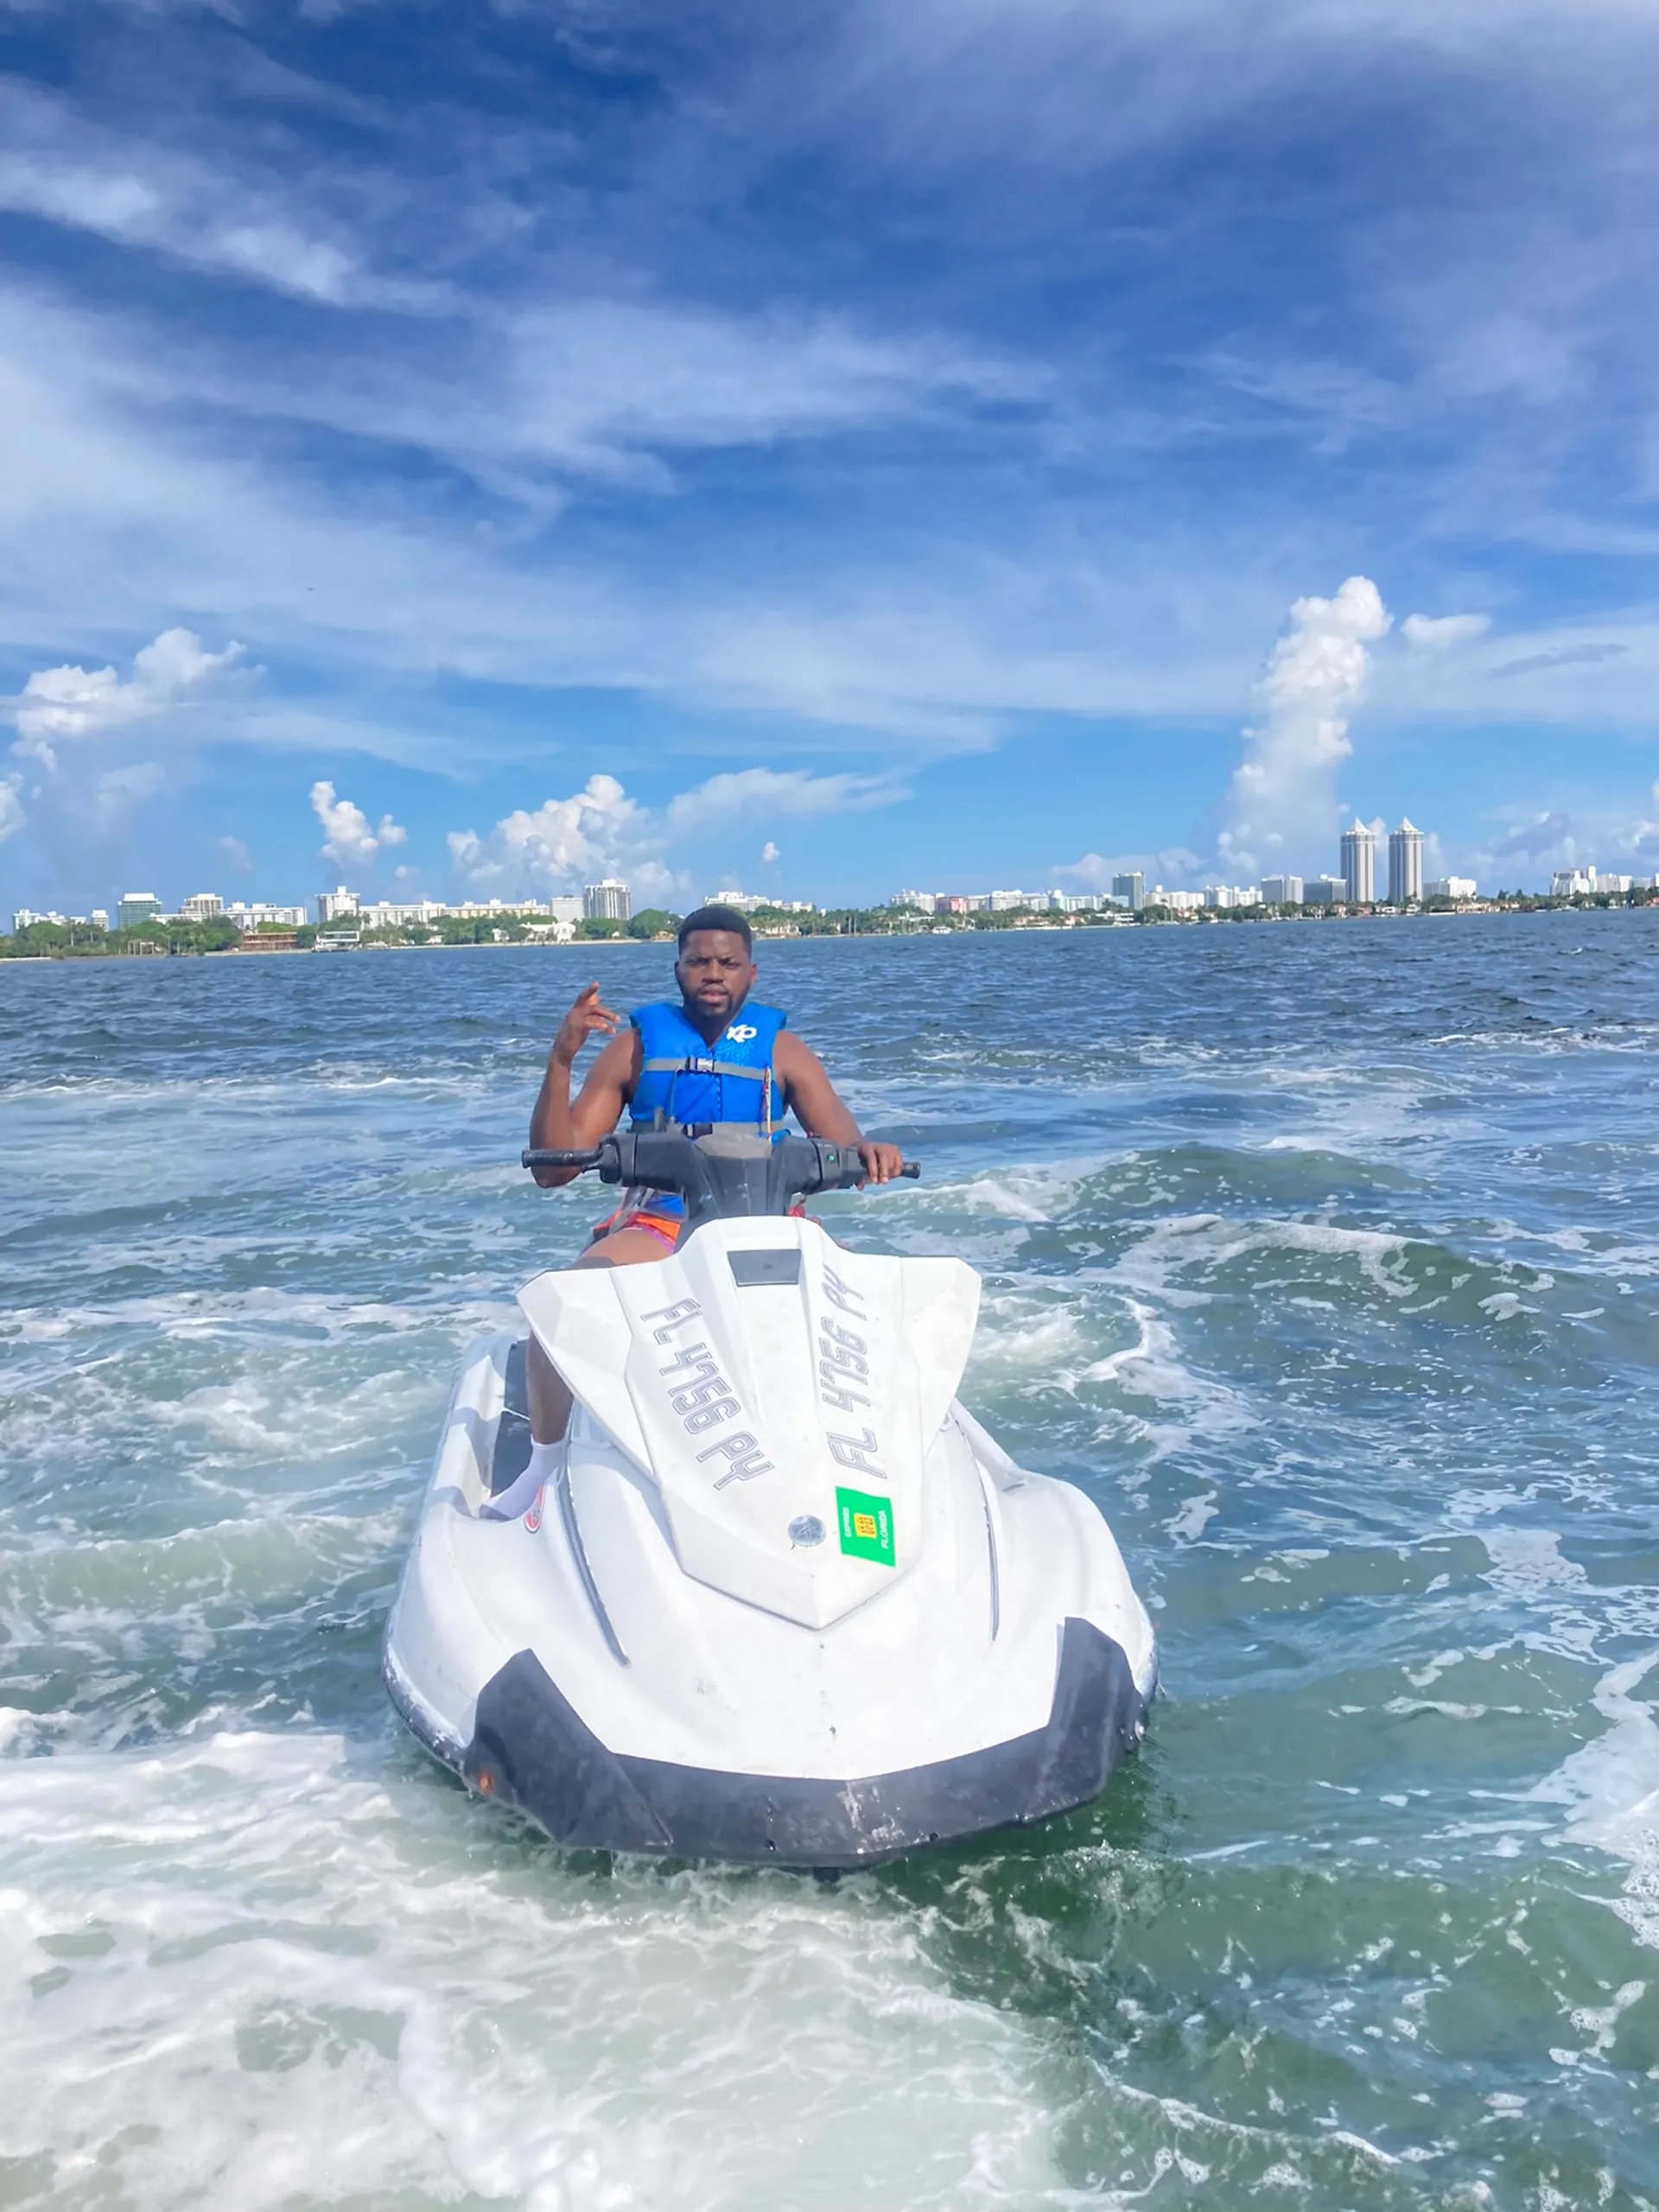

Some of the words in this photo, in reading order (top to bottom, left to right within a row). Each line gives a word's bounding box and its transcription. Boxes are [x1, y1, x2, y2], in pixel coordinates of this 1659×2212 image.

[639, 1297, 703, 1345] FL
[821, 1261, 868, 1321] PY
[658, 1342, 741, 1435] 4756
[818, 1316, 871, 1413] 4756
[696, 1431, 775, 1491] PY
[826, 1427, 888, 1480] FL
[878, 1510, 889, 1549] FLORIDA
